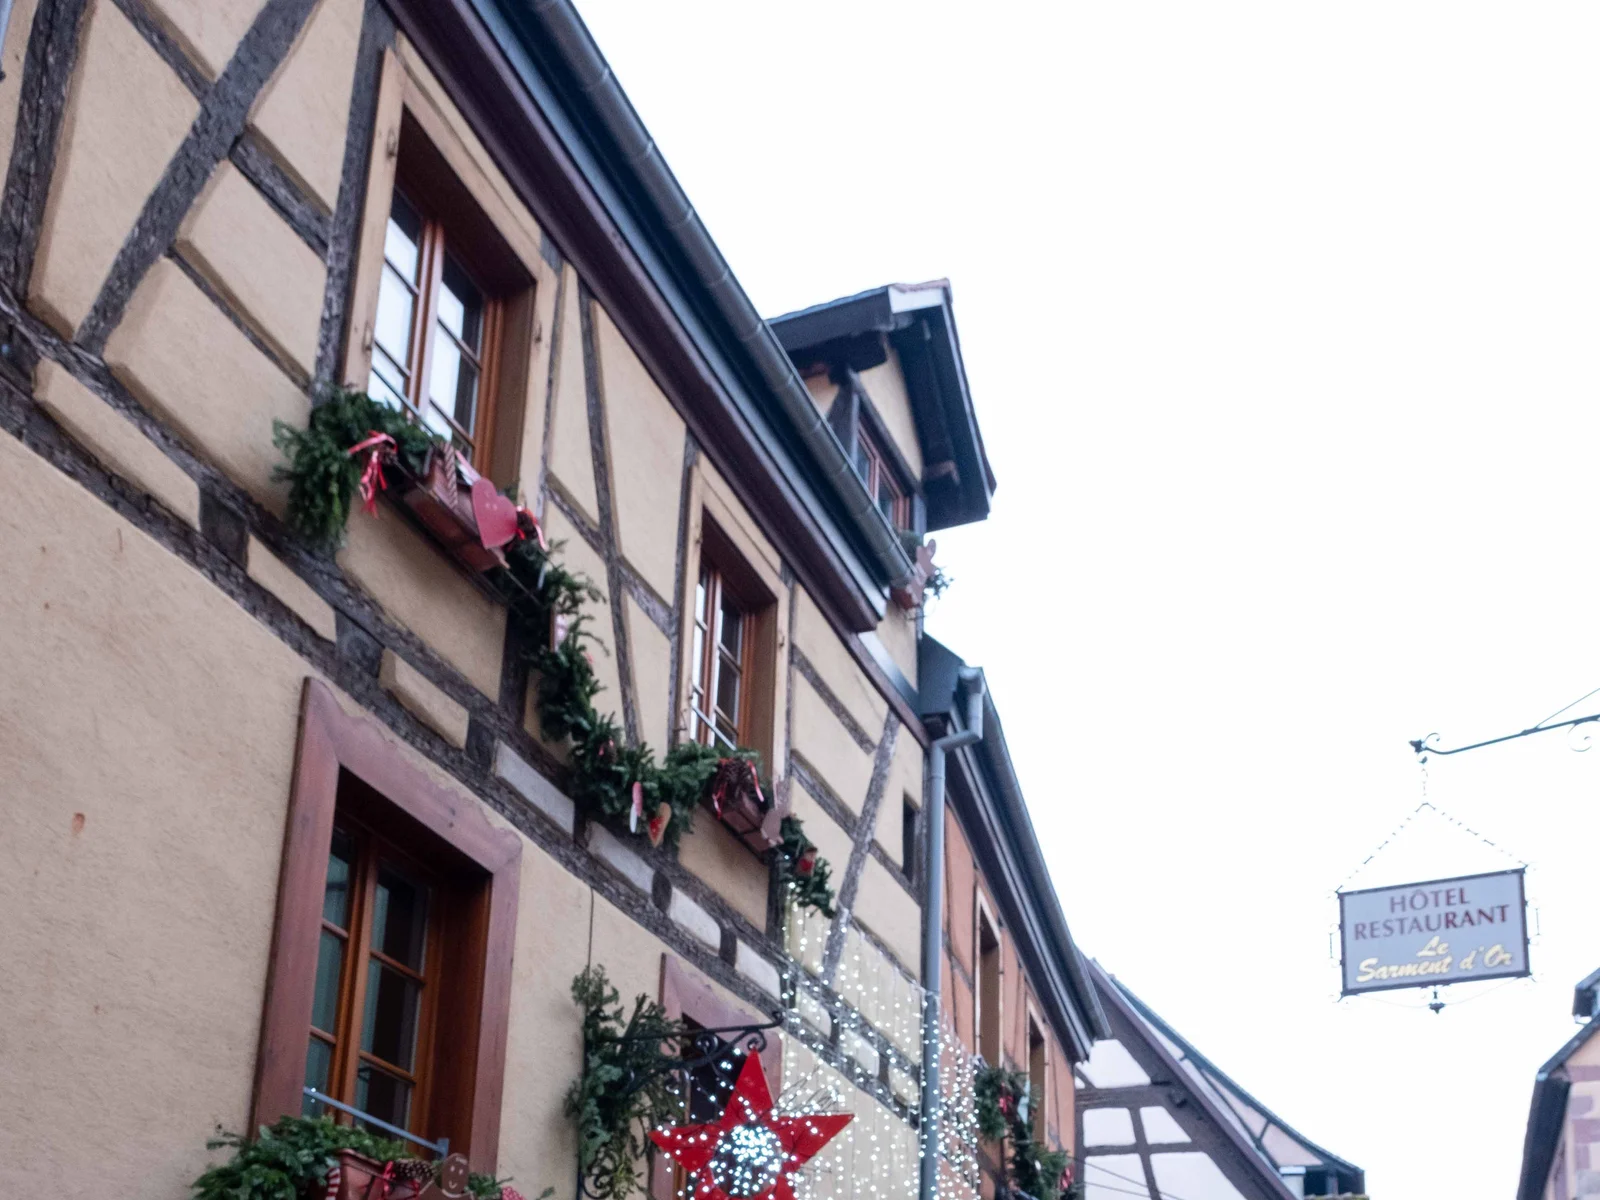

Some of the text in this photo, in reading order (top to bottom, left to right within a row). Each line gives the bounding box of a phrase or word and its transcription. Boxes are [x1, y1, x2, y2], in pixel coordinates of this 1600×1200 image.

[1390, 887, 1470, 914] HÔTEL
[1354, 904, 1510, 940] RESTAURANT
[1416, 935, 1450, 958] Le
[1356, 944, 1514, 983] Sarment d'Or
